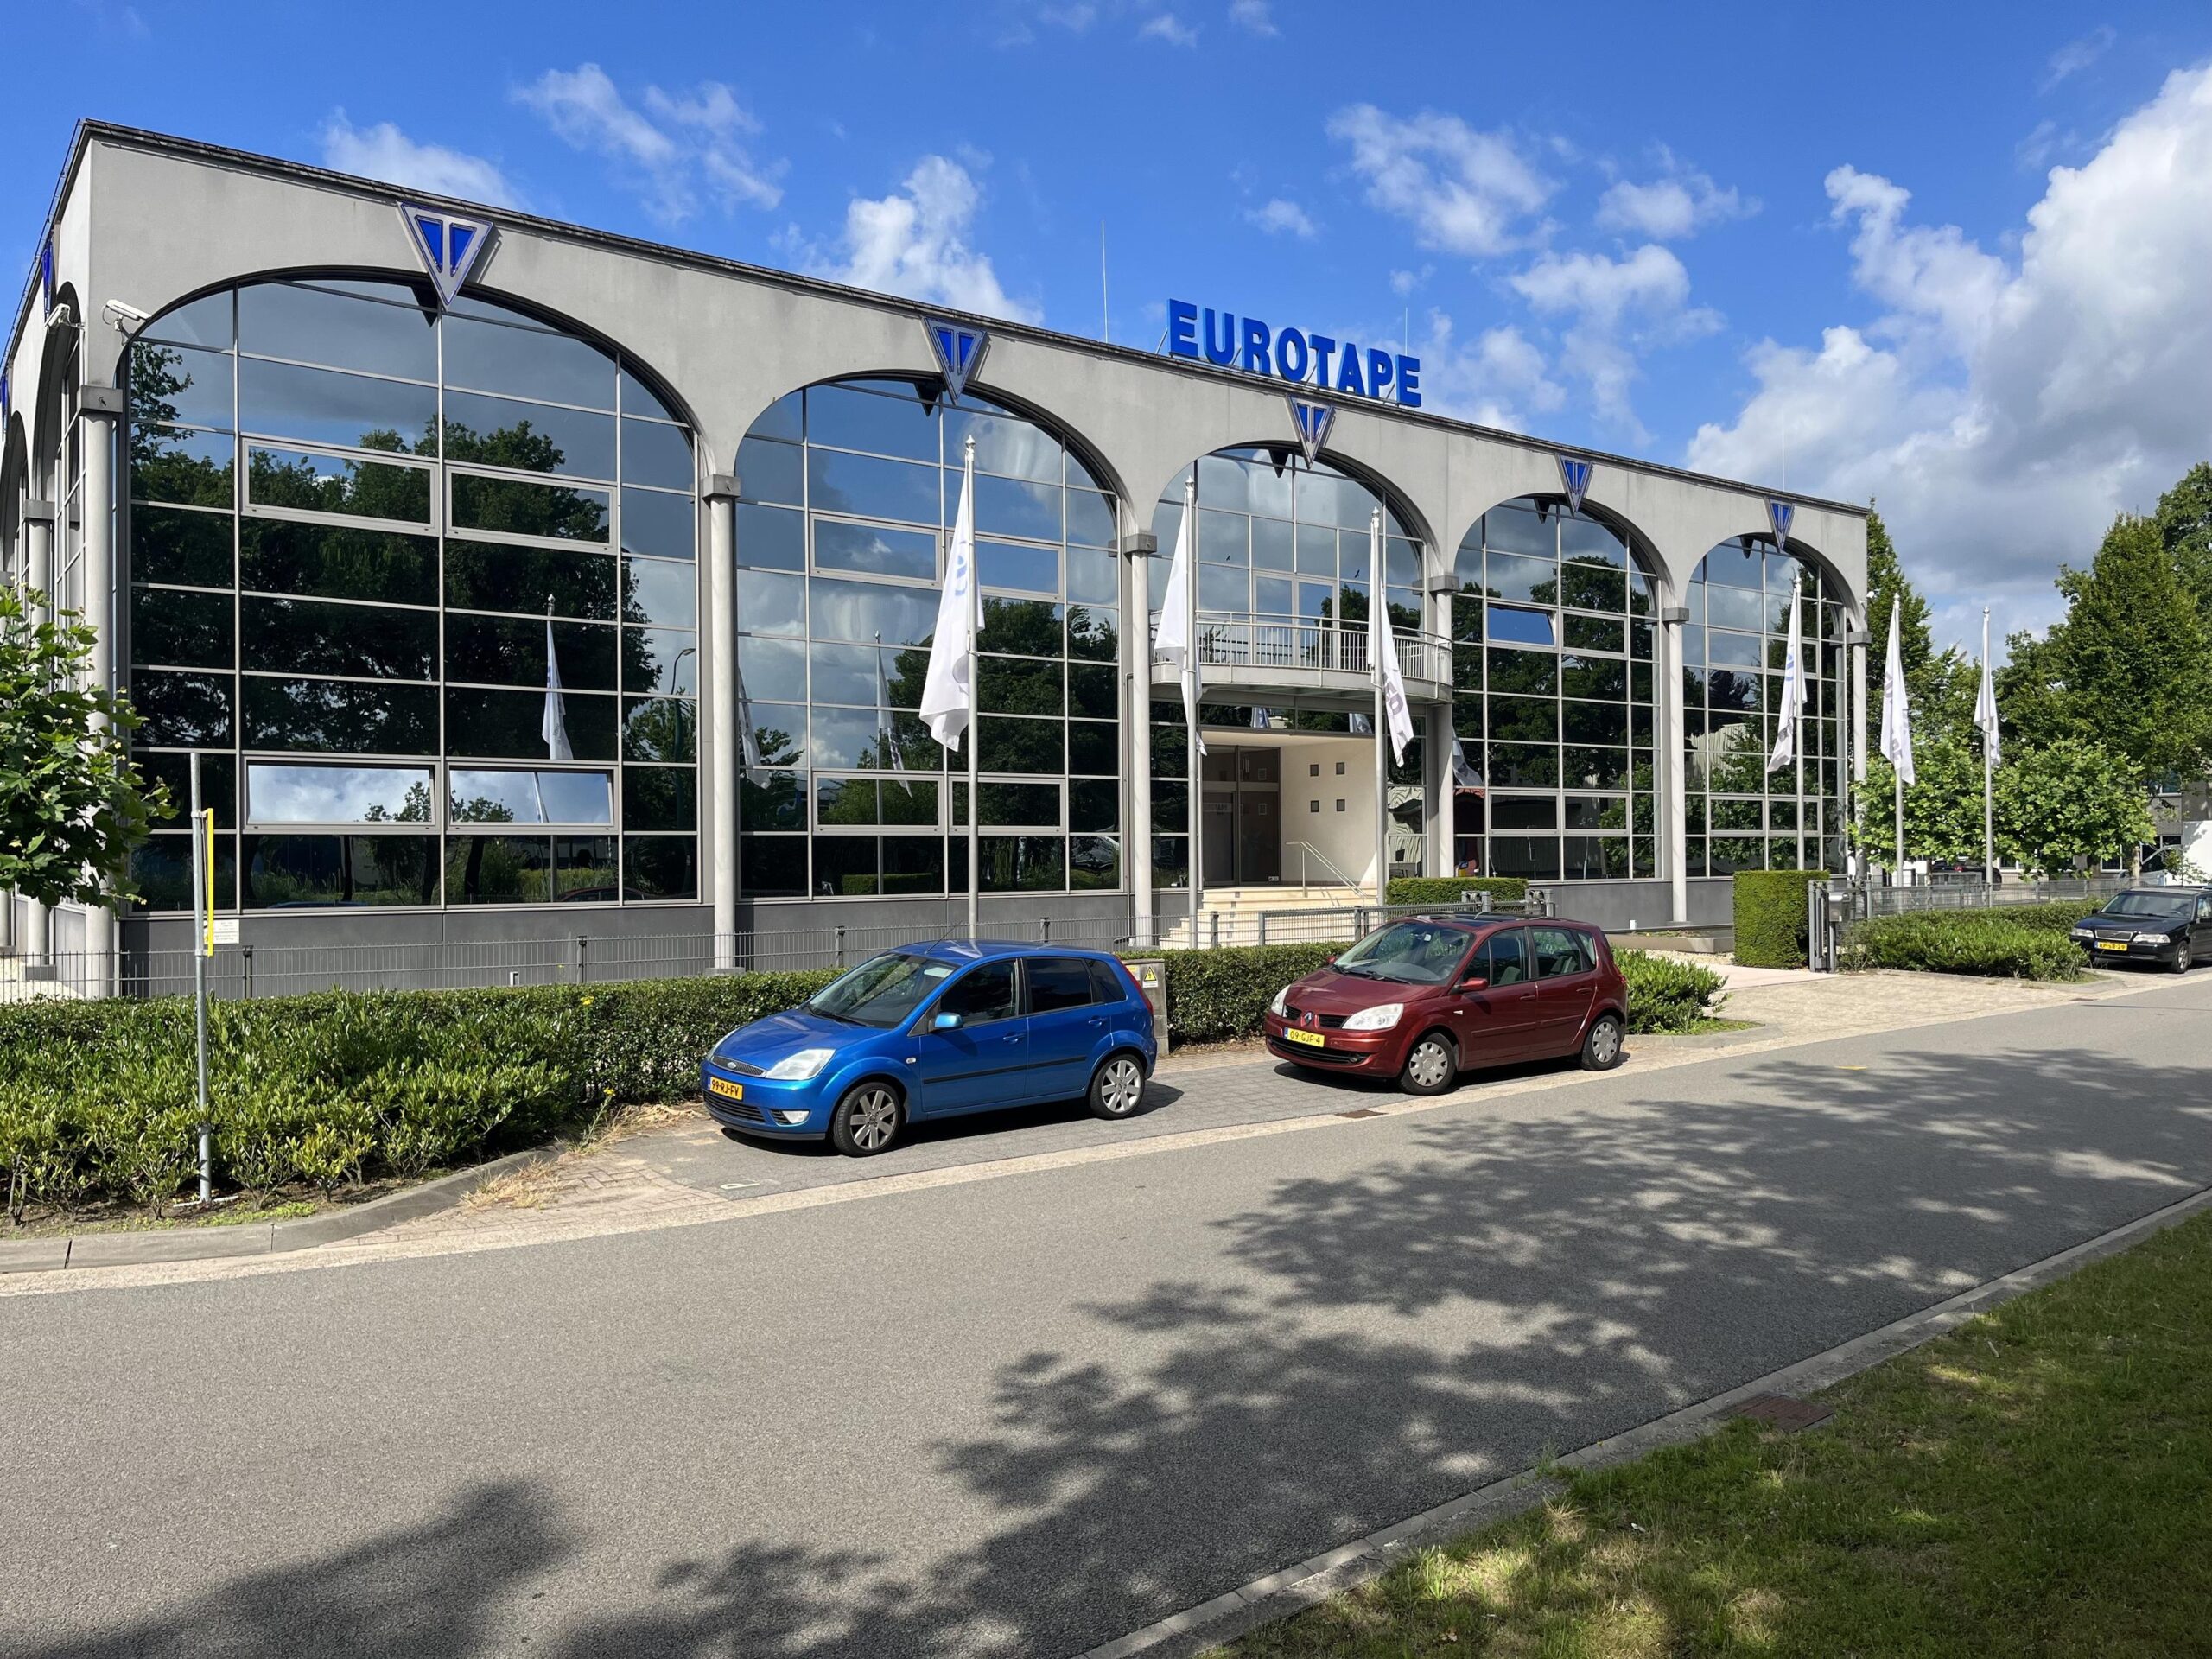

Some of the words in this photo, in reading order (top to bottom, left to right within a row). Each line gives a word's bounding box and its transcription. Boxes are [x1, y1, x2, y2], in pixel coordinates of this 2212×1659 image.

[1167, 298, 1422, 408] EUROTAPE
[1289, 1030, 1320, 1045] 09-GJF-4
[711, 1079, 740, 1097] 99-RJ-FV
